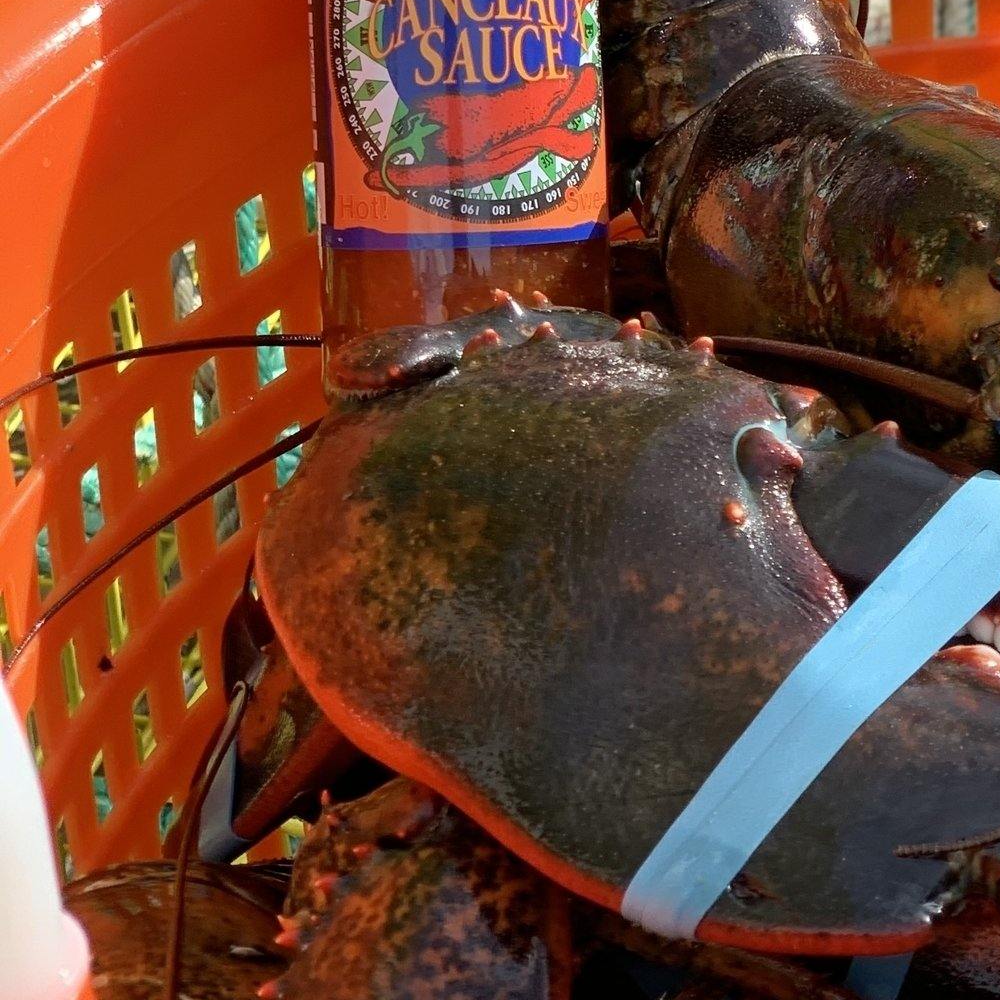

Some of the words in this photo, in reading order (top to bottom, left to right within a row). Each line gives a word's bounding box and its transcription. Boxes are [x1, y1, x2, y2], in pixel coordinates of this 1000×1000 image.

[333, 0, 341, 20] 280
[333, 28, 341, 50] 270
[414, 23, 571, 87] SAUCE
[335, 57, 345, 79] 260
[340, 85, 351, 107] 250
[348, 114, 362, 136] 240
[362, 140, 379, 161] 230
[566, 172, 580, 188] 150
[429, 194, 451, 210] 200
[521, 198, 539, 212] 170
[545, 187, 562, 203] 160
[566, 188, 605, 213] Swe
[460, 204, 480, 216] 190
[492, 204, 511, 216] 180
